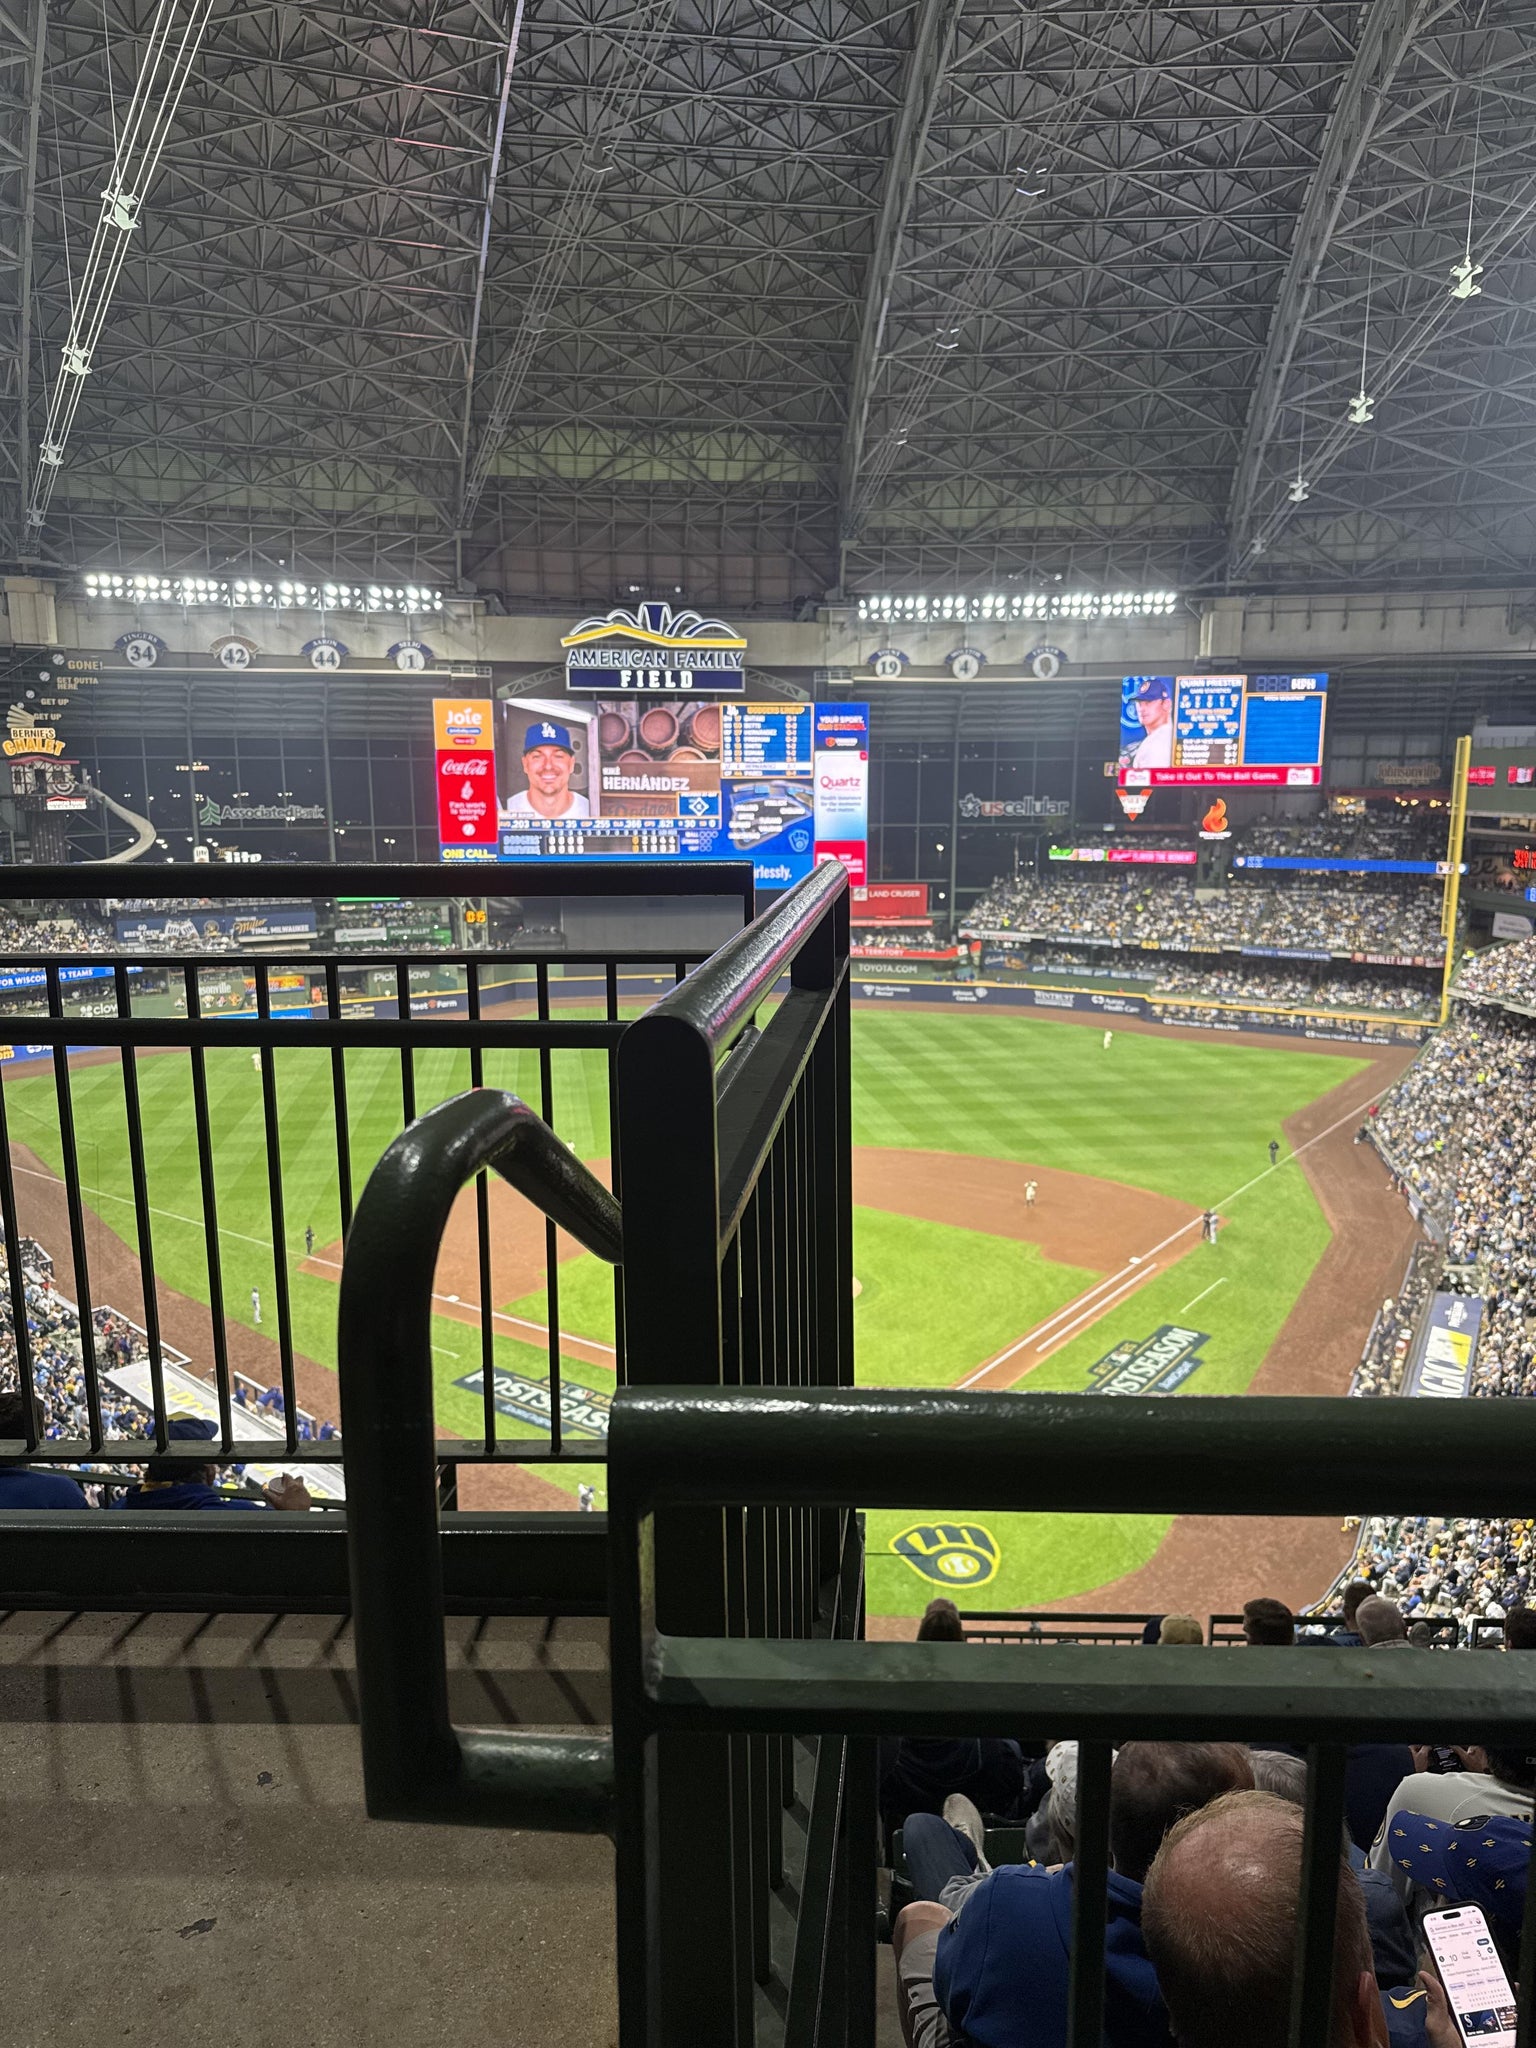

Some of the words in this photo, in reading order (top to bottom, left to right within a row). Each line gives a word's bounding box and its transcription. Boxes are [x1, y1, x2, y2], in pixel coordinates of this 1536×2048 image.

[123, 632, 158, 645] FINGERS
[312, 640, 338, 648] AARON
[130, 645, 154, 662] 34
[223, 648, 247, 664] 42
[314, 651, 337, 667] 44
[566, 649, 669, 668] AMERICAN
[674, 651, 744, 669] FAMILY
[67, 660, 104, 671] GONE!
[406, 654, 418, 670] 1
[879, 660, 899, 675] 19
[959, 660, 969, 675] 4
[620, 670, 693, 688] FIELD
[58, 698, 70, 706] UP
[51, 713, 62, 721] UP
[11, 728, 56, 739] BERNIE'S
[2, 738, 66, 756] CHALET
[602, 774, 690, 791] HERNÁNDEZ
[820, 776, 861, 790] Quartz
[755, 865, 792, 881] rlessly.
[869, 890, 889, 898] LAND
[890, 890, 920, 898] CRUISER
[69, 969, 94, 979] TEAMS
[859, 963, 917, 974] TOYOTA.COM
[437, 1000, 457, 1009] Farm
[1101, 1327, 1200, 1395] OSTSEASON
